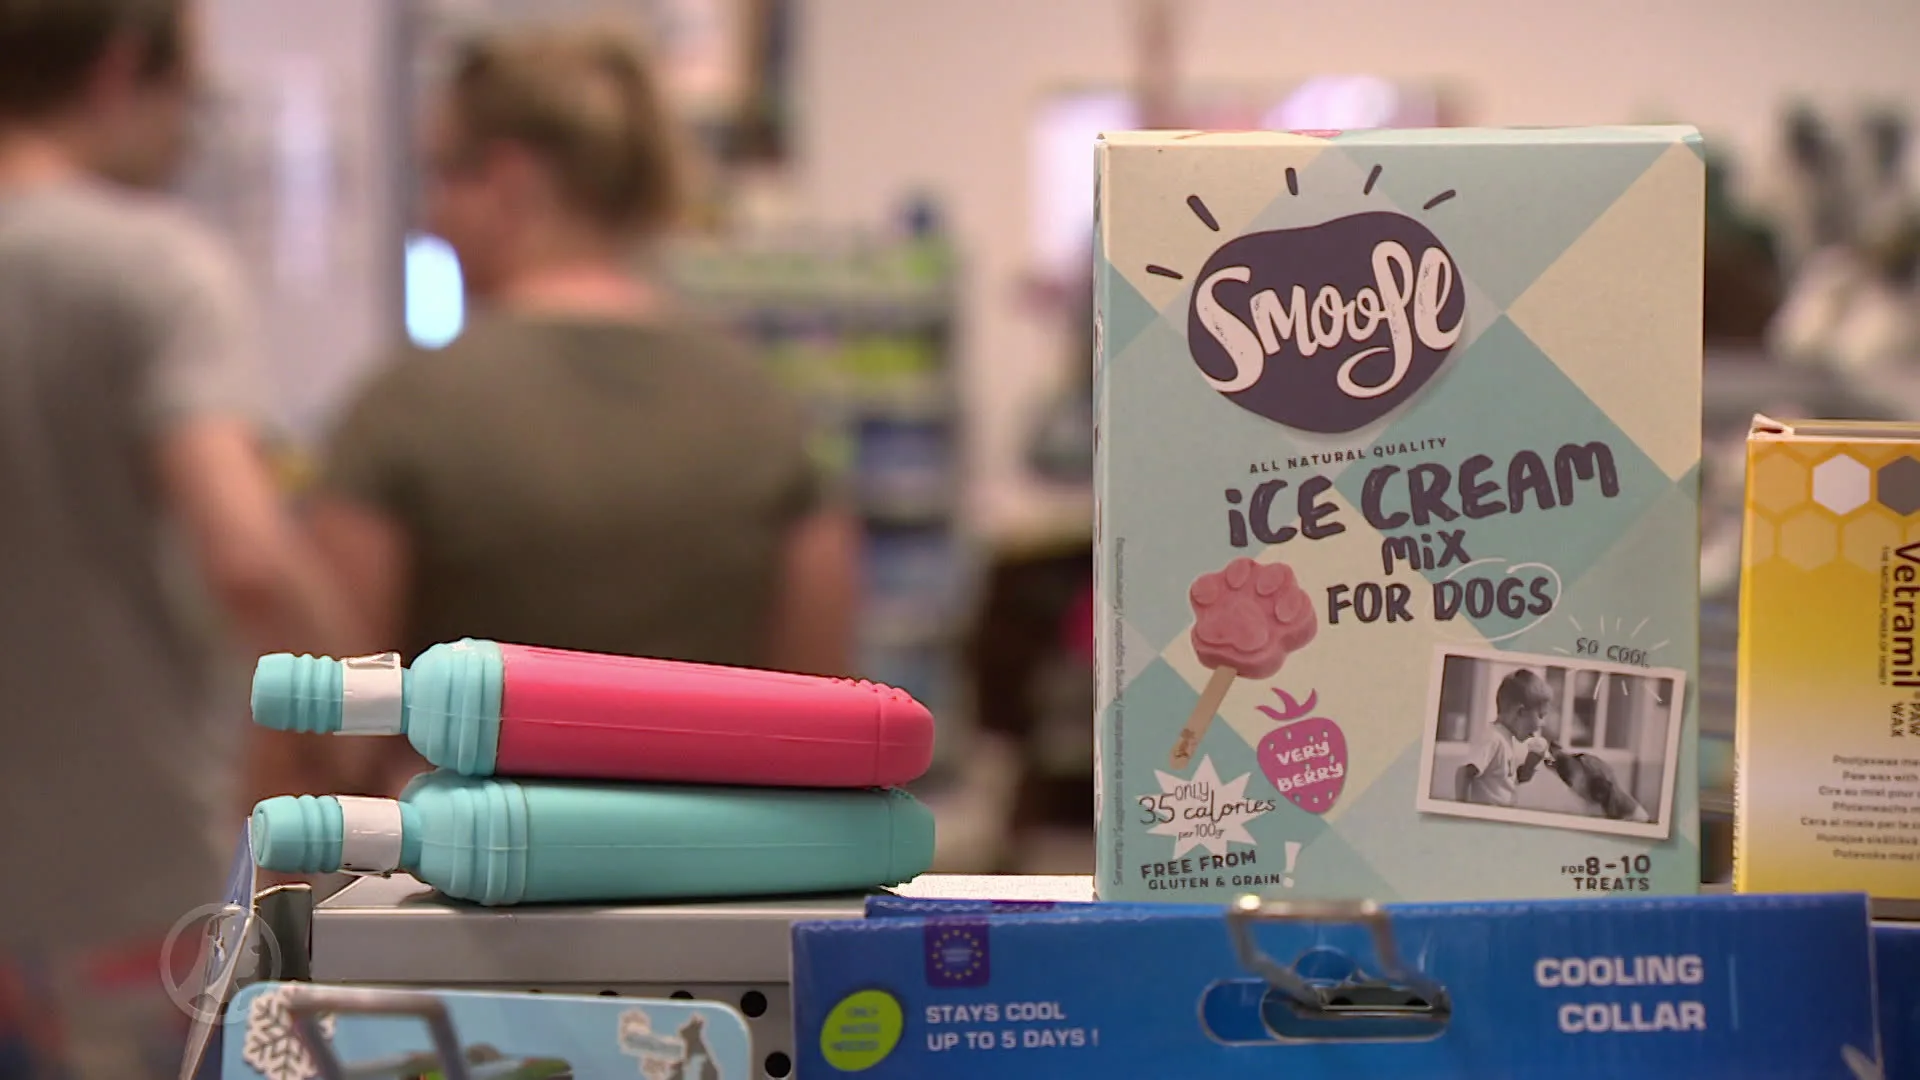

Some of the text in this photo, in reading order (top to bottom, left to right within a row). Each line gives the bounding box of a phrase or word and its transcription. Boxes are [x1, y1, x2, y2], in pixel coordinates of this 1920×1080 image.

[1250, 437, 1447, 474] ALL NATURAL QUALITY
[1361, 441, 1620, 532] CREAM
[1327, 577, 1554, 625] FOR DOGS
[1892, 542, 1920, 687] Vetramil
[1576, 637, 1599, 654] SO
[1891, 702, 1905, 738] WAX
[1276, 741, 1330, 766] VERY
[1277, 762, 1344, 792] BERRY
[1139, 789, 1277, 825] 35 calories
[1140, 850, 1257, 879] FREE FROM
[1561, 865, 1585, 874] FOR
[1148, 877, 1209, 890] GLUTEN
[1215, 875, 1226, 887] &
[1231, 874, 1280, 887] GRAIN
[1573, 877, 1650, 890] TREATS
[1534, 955, 1705, 988] COOLING
[925, 1002, 1067, 1024] STAYS COOL
[1558, 1002, 1706, 1034] COLLAR
[927, 1032, 960, 1051] UP
[965, 1030, 995, 1050] TO
[1001, 1031, 1017, 1049] 5
[1023, 1029, 1085, 1049] DAYS
